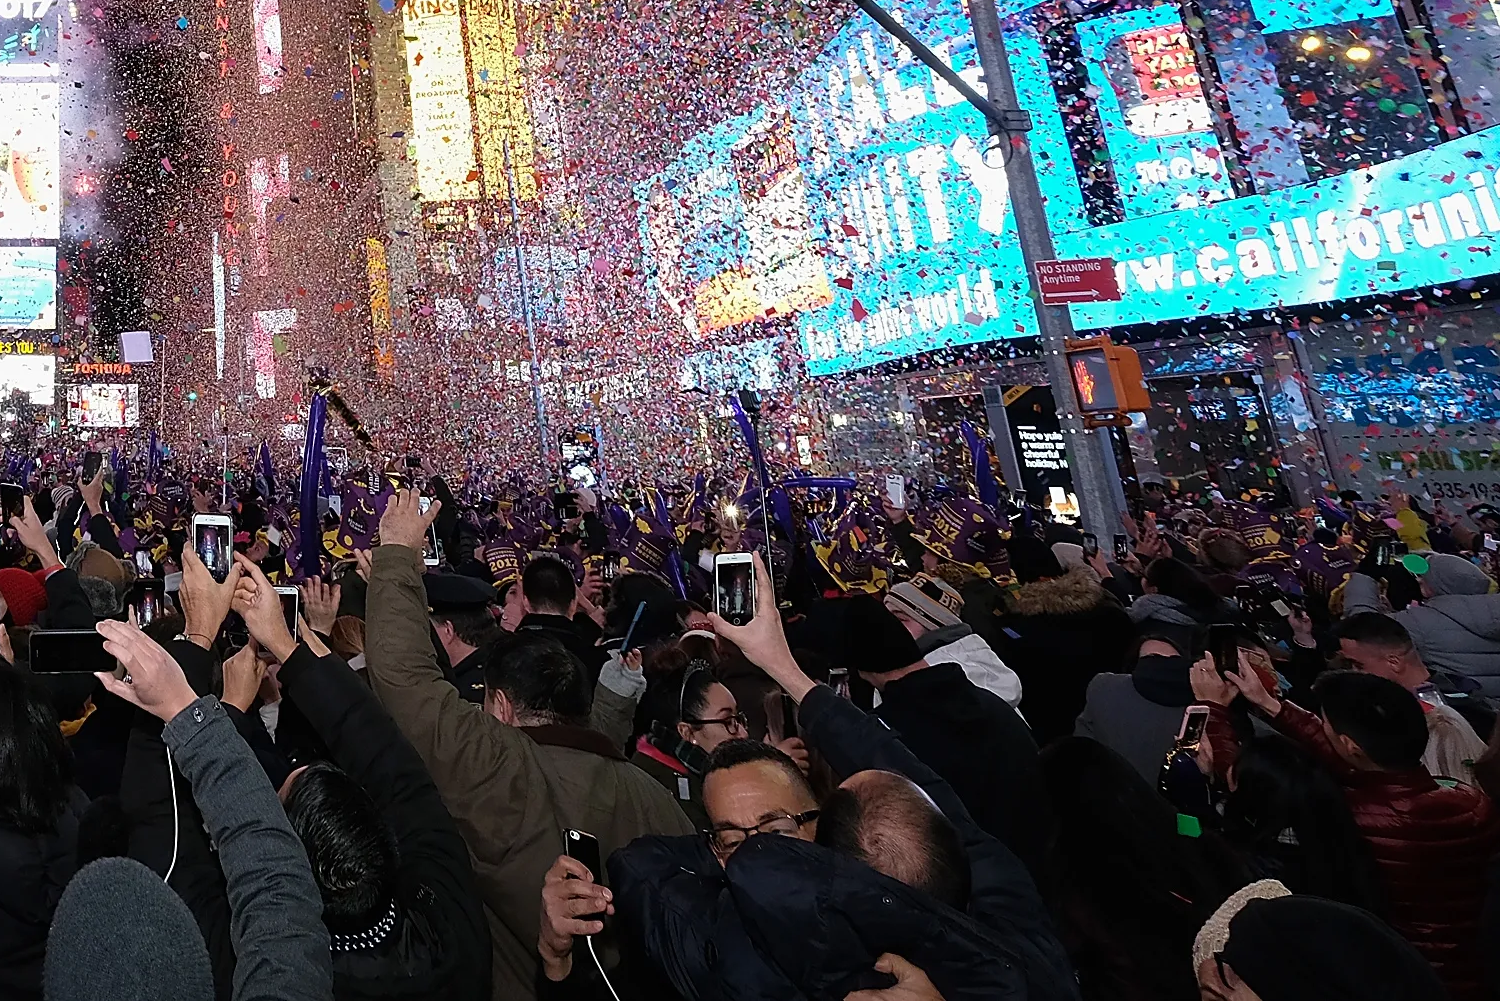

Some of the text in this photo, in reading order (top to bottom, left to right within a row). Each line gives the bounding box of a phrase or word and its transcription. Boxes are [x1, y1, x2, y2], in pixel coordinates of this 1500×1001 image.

[1040, 262, 1102, 274] NO STANDING
[1043, 274, 1081, 285] Anytime
[1023, 449, 1060, 460] cheerful
[1025, 458, 1059, 470] holiday,
[489, 558, 519, 573] 2017
